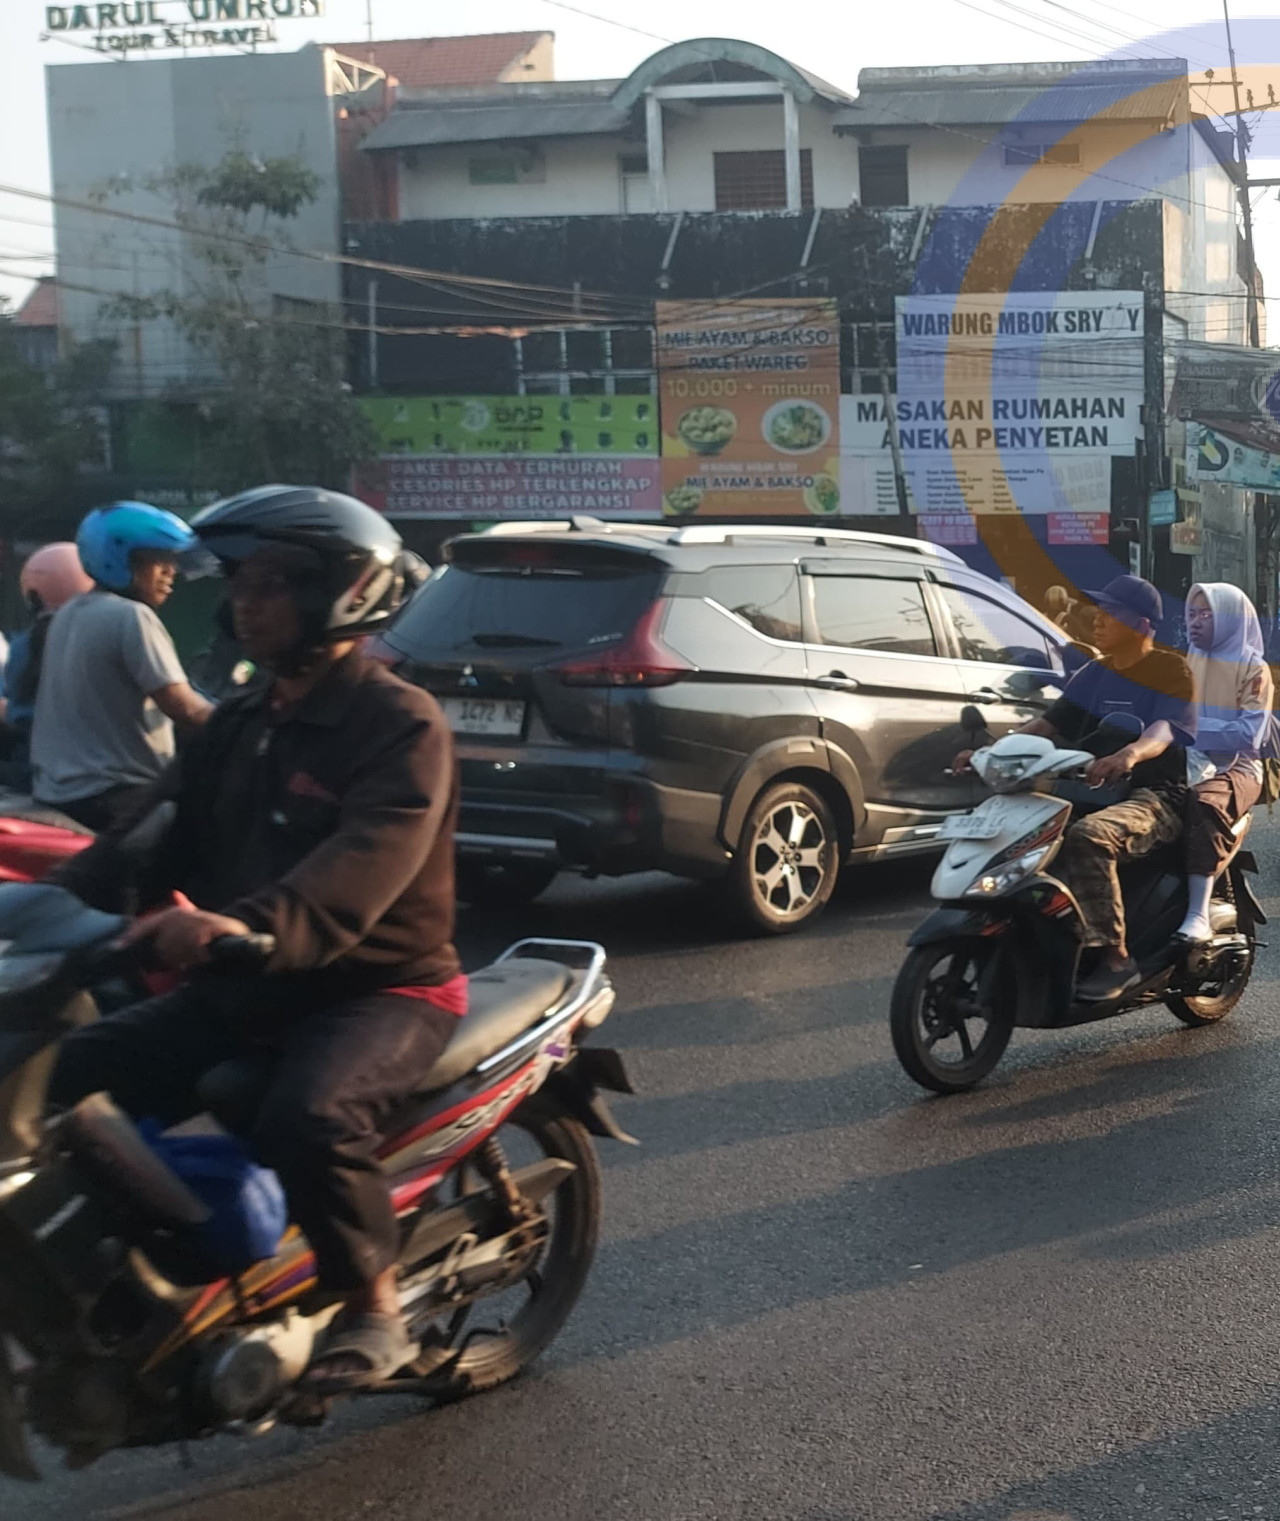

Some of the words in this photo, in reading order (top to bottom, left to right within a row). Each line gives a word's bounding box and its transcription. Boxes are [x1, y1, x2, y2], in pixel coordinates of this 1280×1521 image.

[46, 1, 167, 30] DARUL
[93, 33, 157, 50] TOUR
[184, 25, 277, 46] TRAVEL
[902, 312, 993, 336] WARUNG
[998, 310, 1059, 335] MBOK
[697, 331, 747, 345] AYAM
[769, 329, 831, 345] BAKSO
[667, 379, 737, 397] 10.000
[761, 378, 831, 396] minum
[857, 400, 984, 423] MASAKAN
[993, 397, 1126, 420] RUMAHAN
[881, 428, 968, 450] ANEKA
[976, 425, 1109, 448] PENYETAN
[457, 462, 508, 475] DATA
[513, 460, 622, 475] TERMURAH
[522, 477, 651, 492] TERLENGKAP
[712, 475, 750, 488] AYAM
[768, 474, 814, 488] BAKSO
[386, 494, 467, 509] SERVICE
[471, 494, 498, 508] HP
[502, 494, 631, 509] BERGARANSI
